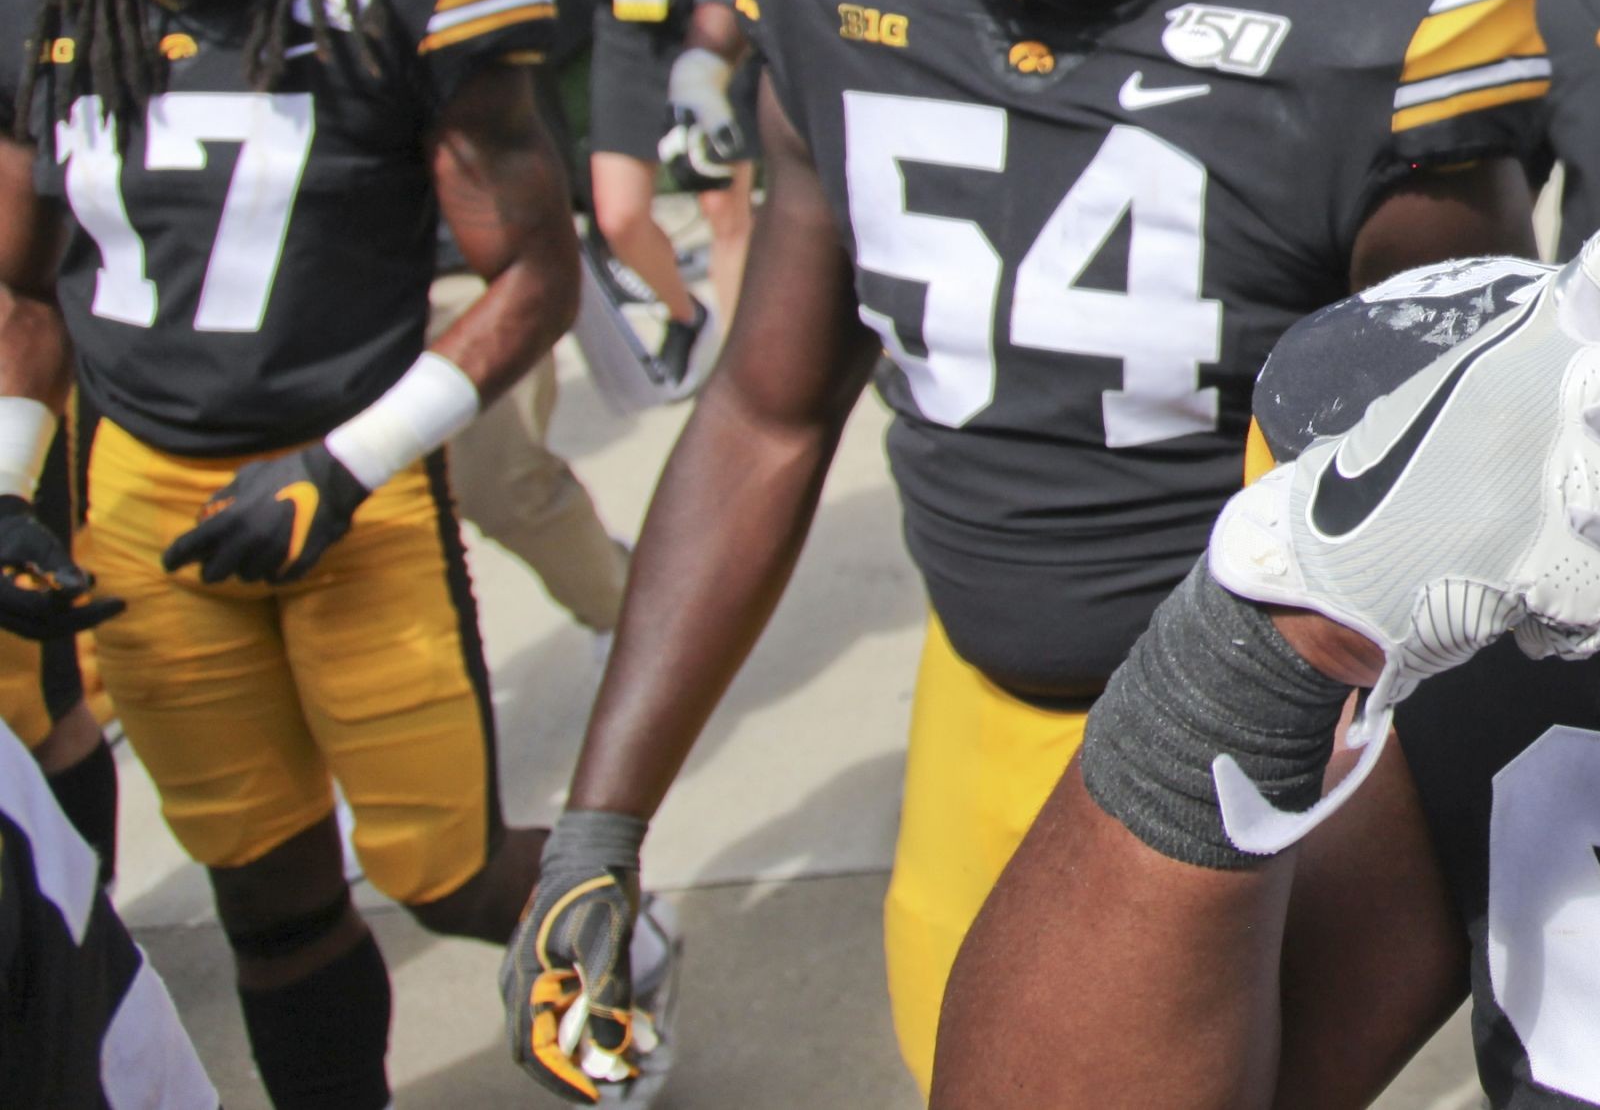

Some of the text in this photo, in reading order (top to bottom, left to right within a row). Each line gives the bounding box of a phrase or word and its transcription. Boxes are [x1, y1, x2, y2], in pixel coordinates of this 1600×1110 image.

[1163, 3, 1291, 77] 150
[56, 92, 315, 332] 17
[843, 90, 1223, 448] 54
